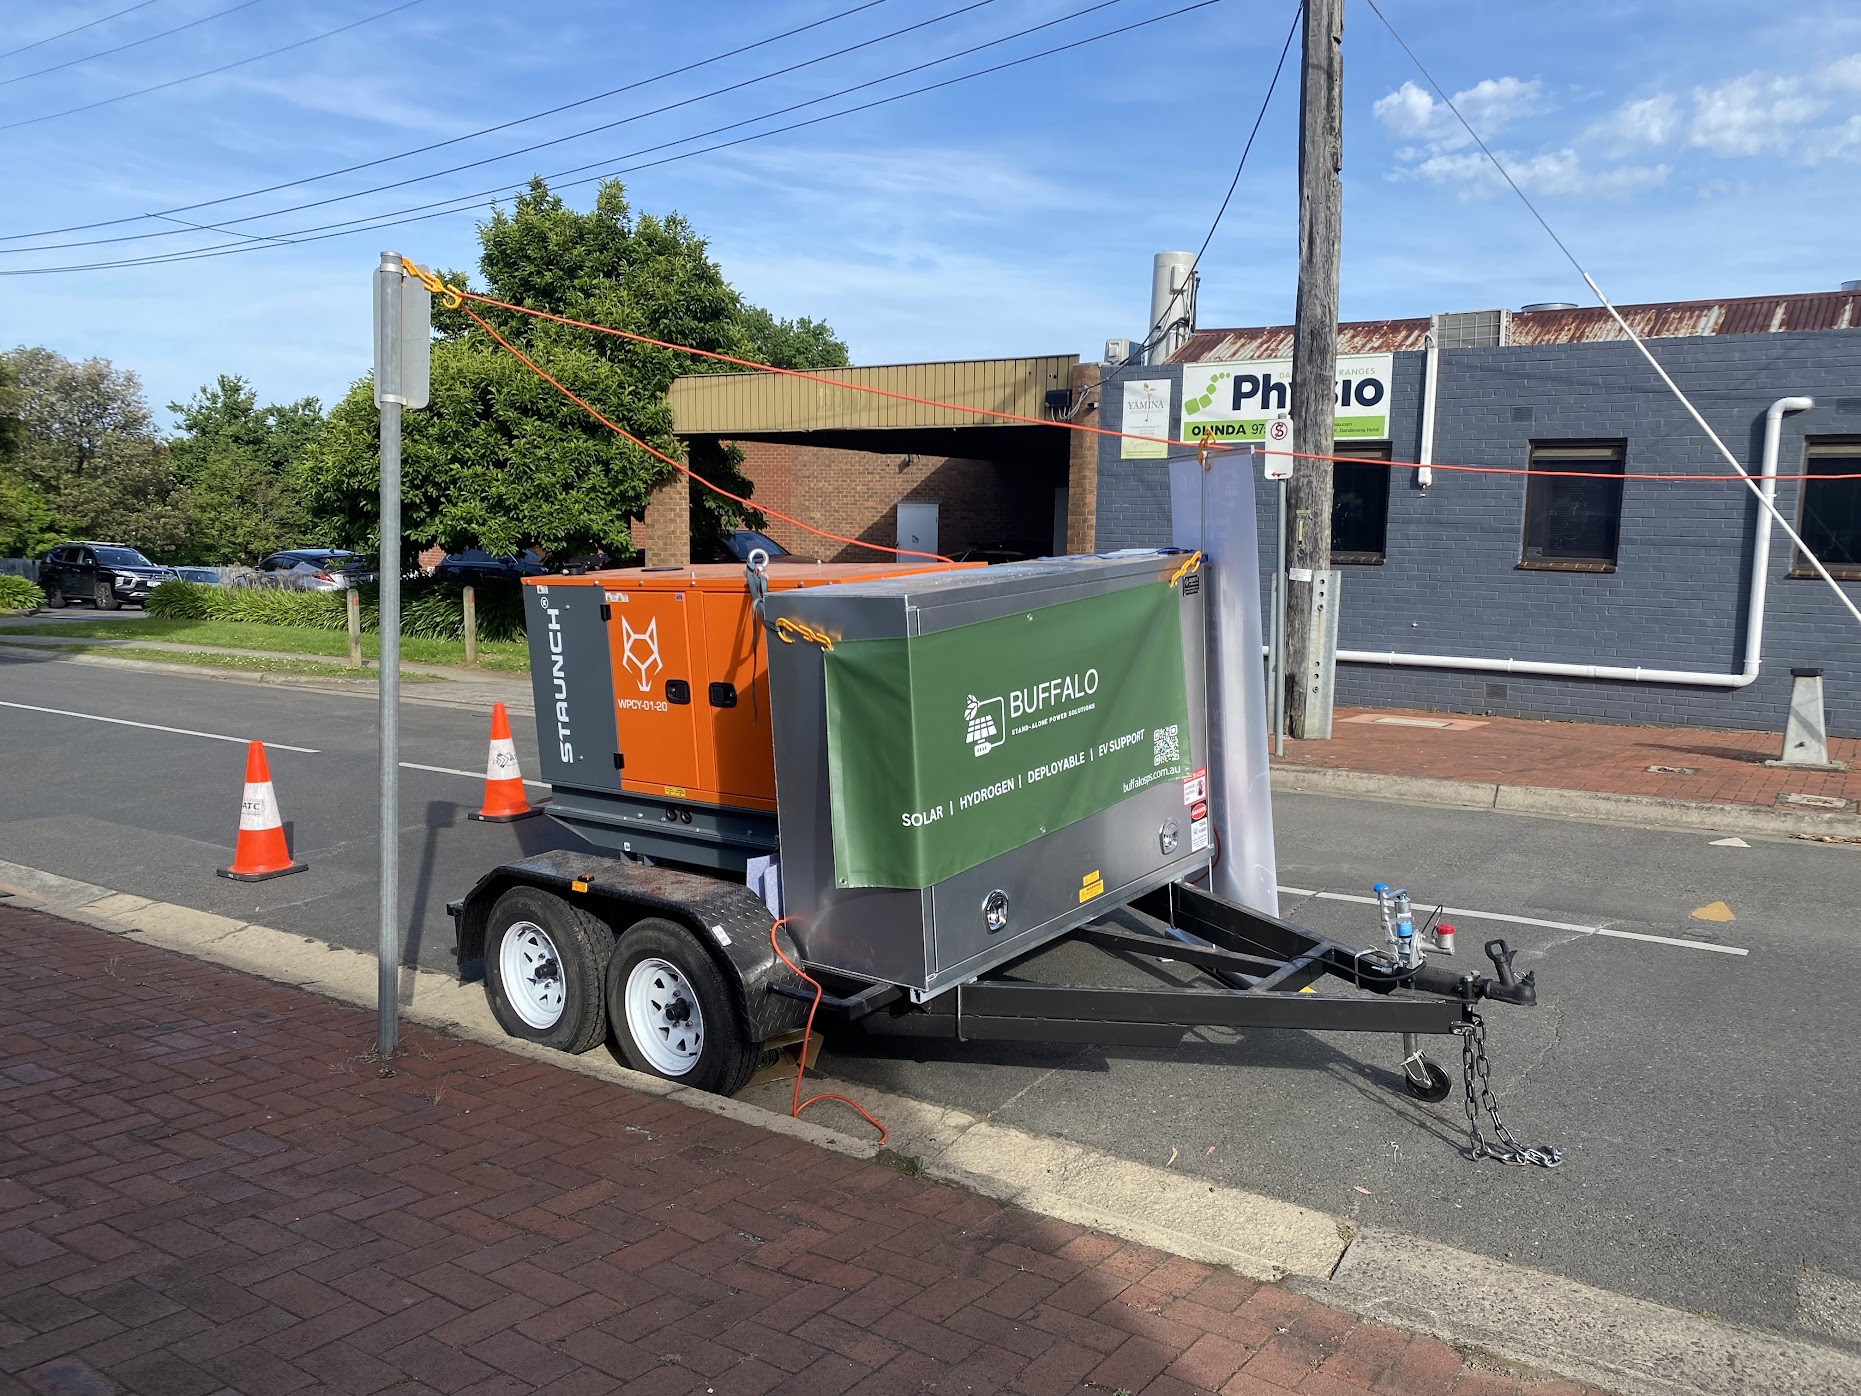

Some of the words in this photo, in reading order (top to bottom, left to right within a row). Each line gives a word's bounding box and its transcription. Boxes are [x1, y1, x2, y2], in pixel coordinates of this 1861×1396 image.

[1339, 367, 1376, 376] RANGES
[1128, 400, 1164, 410] YAMINA
[617, 698, 668, 712] WPCY-01-20
[1010, 668, 1099, 719] BUFFALO
[1011, 718, 1048, 736] STAND-ALONE
[1049, 713, 1068, 723] POWER
[1068, 703, 1096, 717] SOLUTIONS
[901, 805, 944, 828] SOLAR
[959, 778, 1015, 811] HYDROGEN
[1027, 752, 1085, 784] DEPLOYABLE
[1098, 744, 1109, 758] EV
[1109, 728, 1146, 754] SUPPORT
[1122, 765, 1181, 794] buffalosps.com.au
